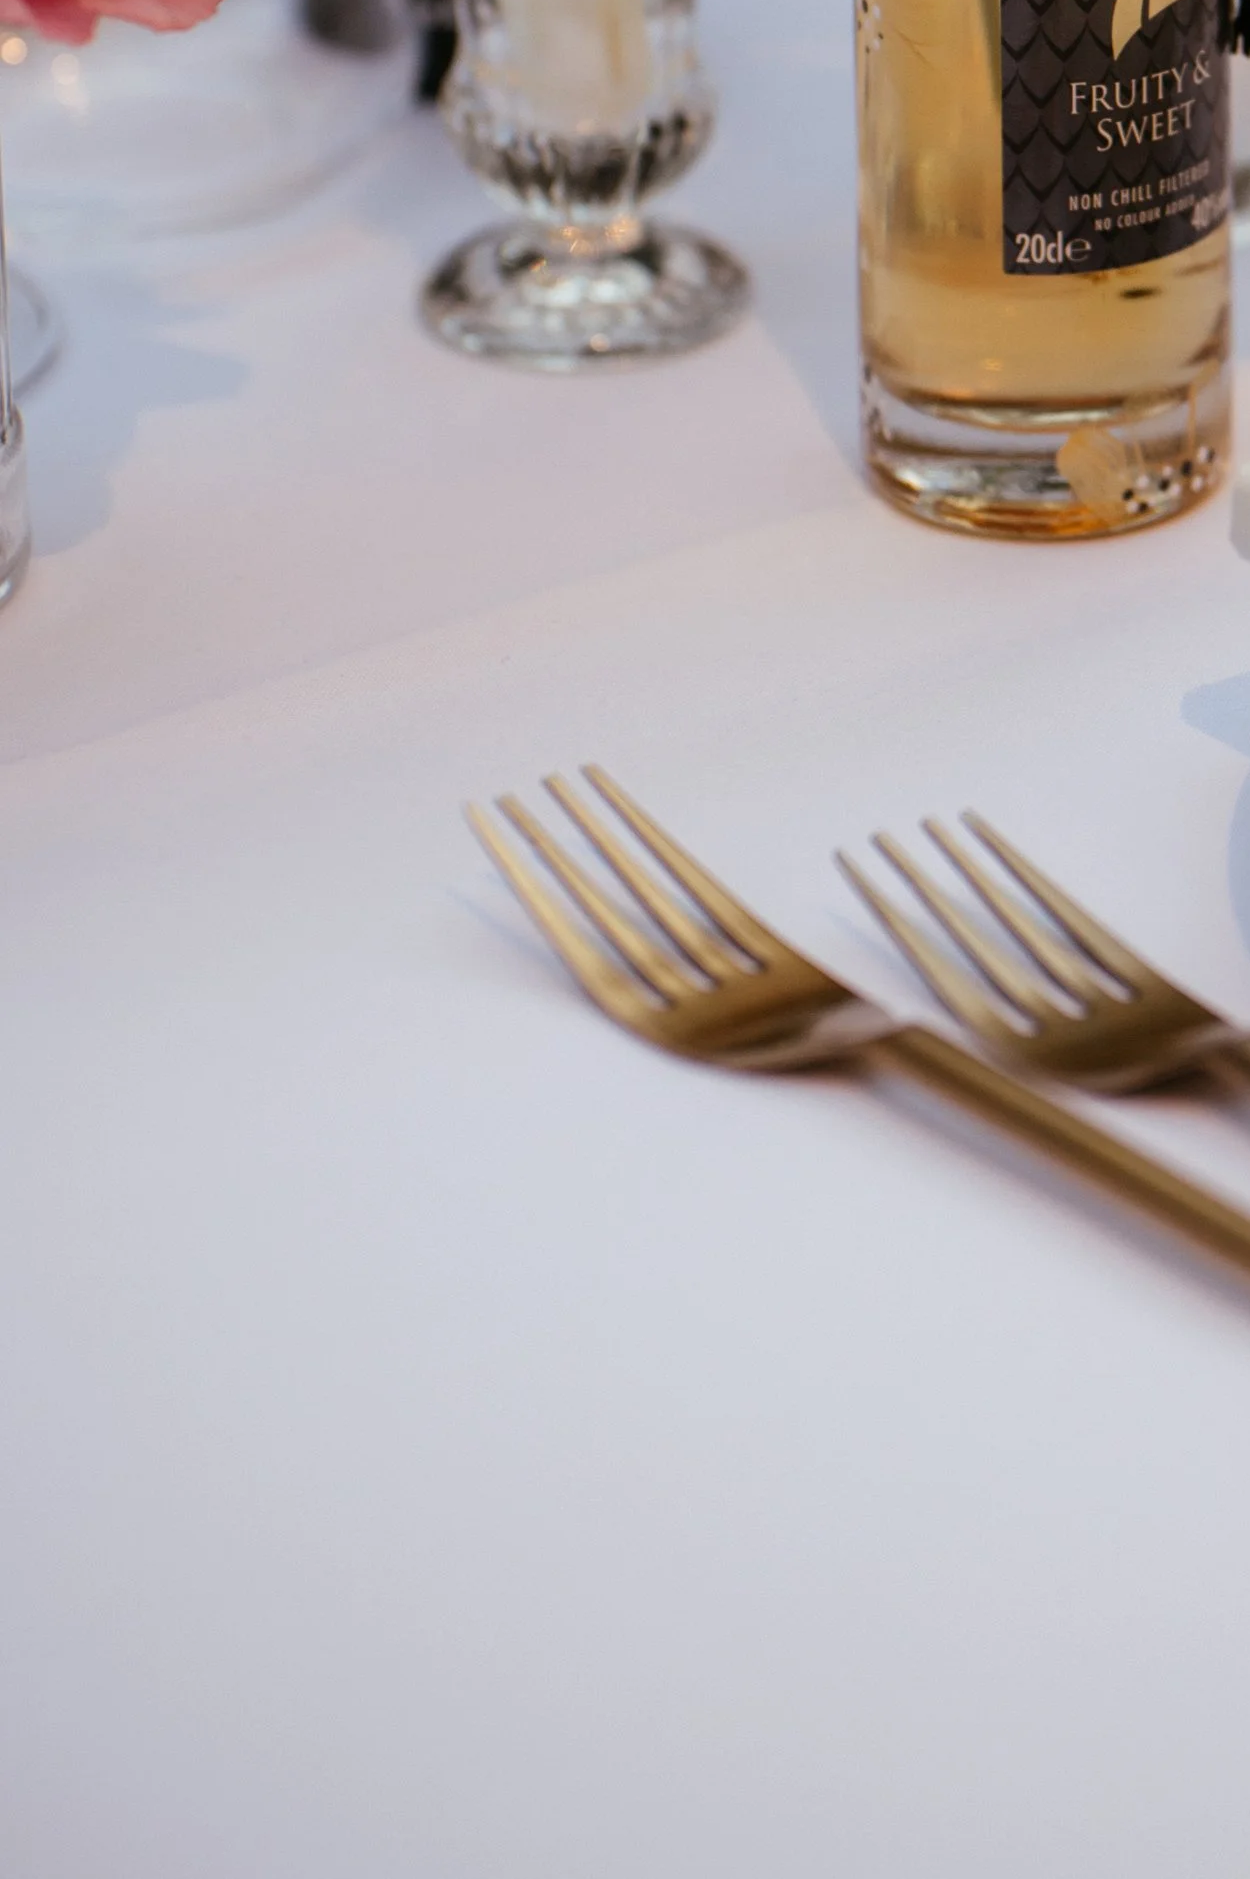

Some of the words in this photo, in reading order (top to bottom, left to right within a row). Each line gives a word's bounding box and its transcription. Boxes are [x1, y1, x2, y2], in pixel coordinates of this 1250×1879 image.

[1069, 62, 1189, 115] FRUITY
[1192, 50, 1212, 85] &
[1096, 99, 1196, 152] SWEET
[1068, 193, 1103, 211] NON
[1111, 183, 1153, 206] CHILL
[1094, 217, 1112, 231] NO
[1117, 206, 1161, 228] COLOUR
